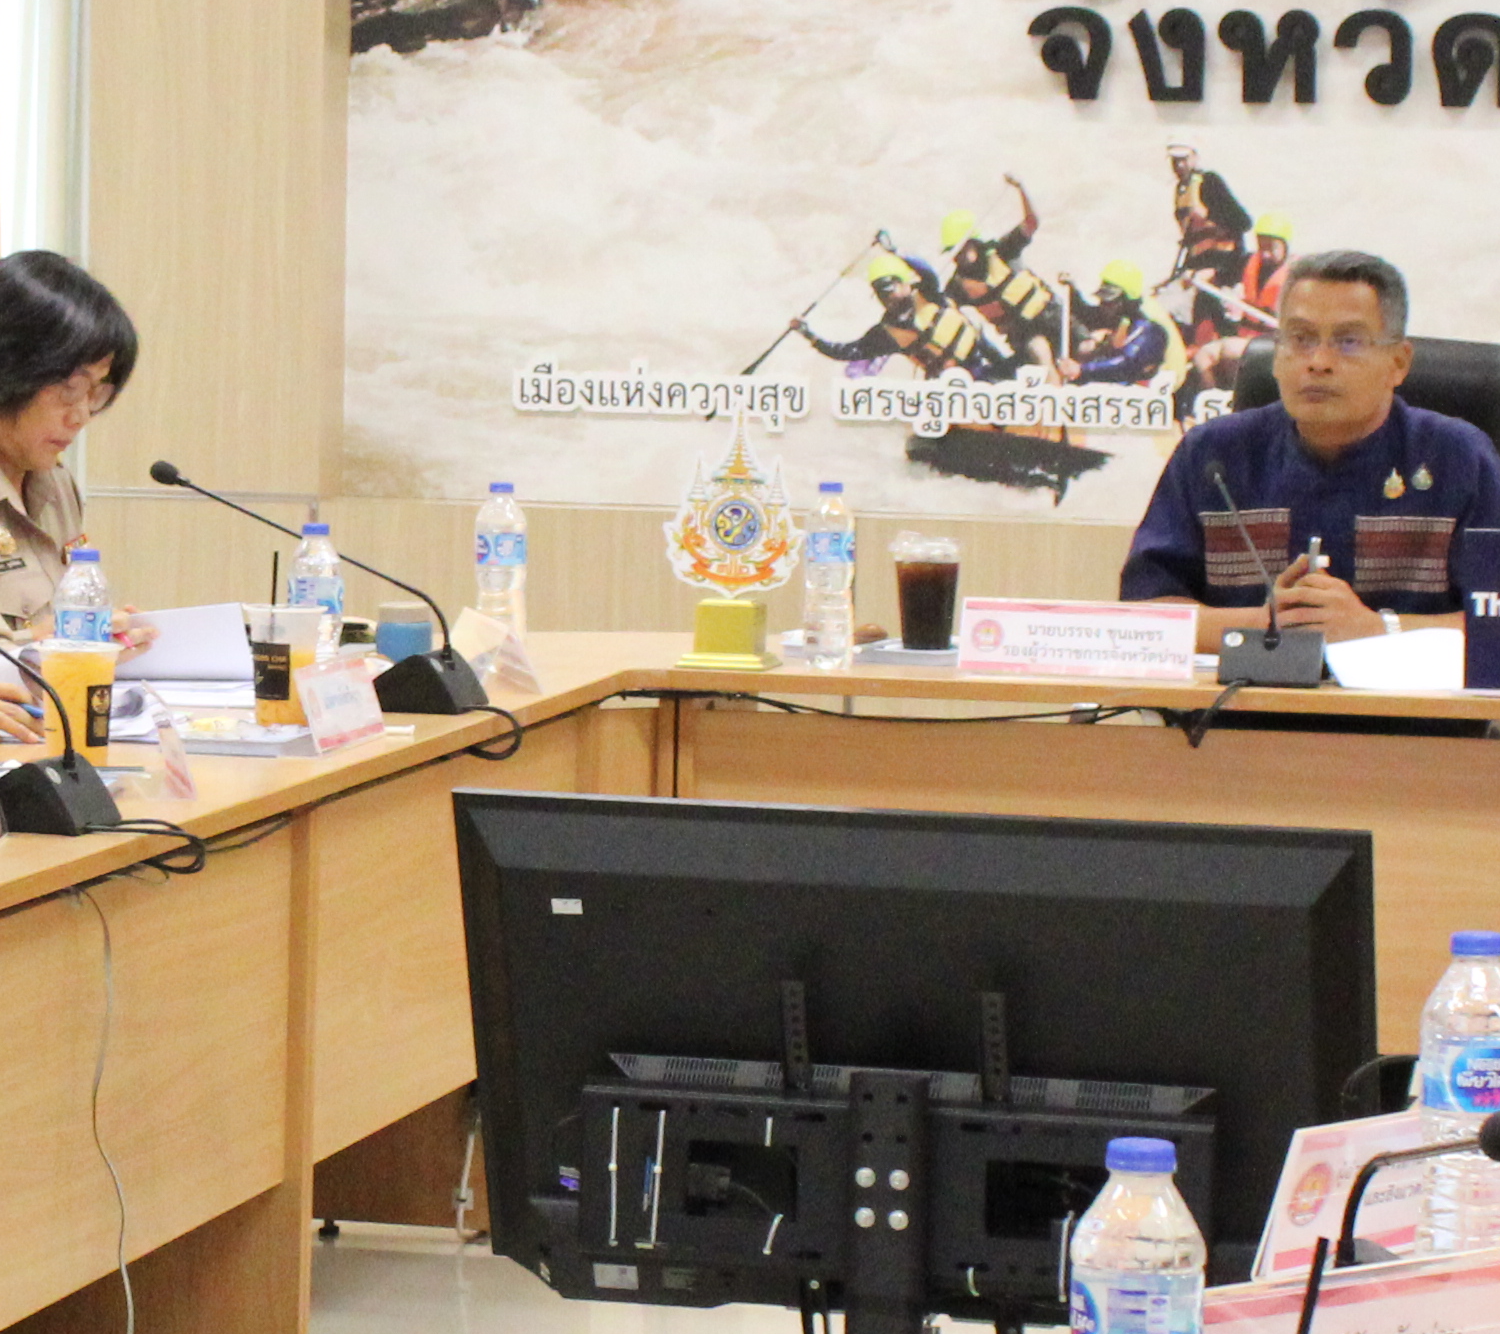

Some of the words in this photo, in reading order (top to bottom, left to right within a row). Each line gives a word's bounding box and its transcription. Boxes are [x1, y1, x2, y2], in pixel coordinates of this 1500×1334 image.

[519, 362, 804, 427] เมืองแห่งความสุข
[839, 374, 1176, 433] เศรษฐกิจสร้างสรรค์
